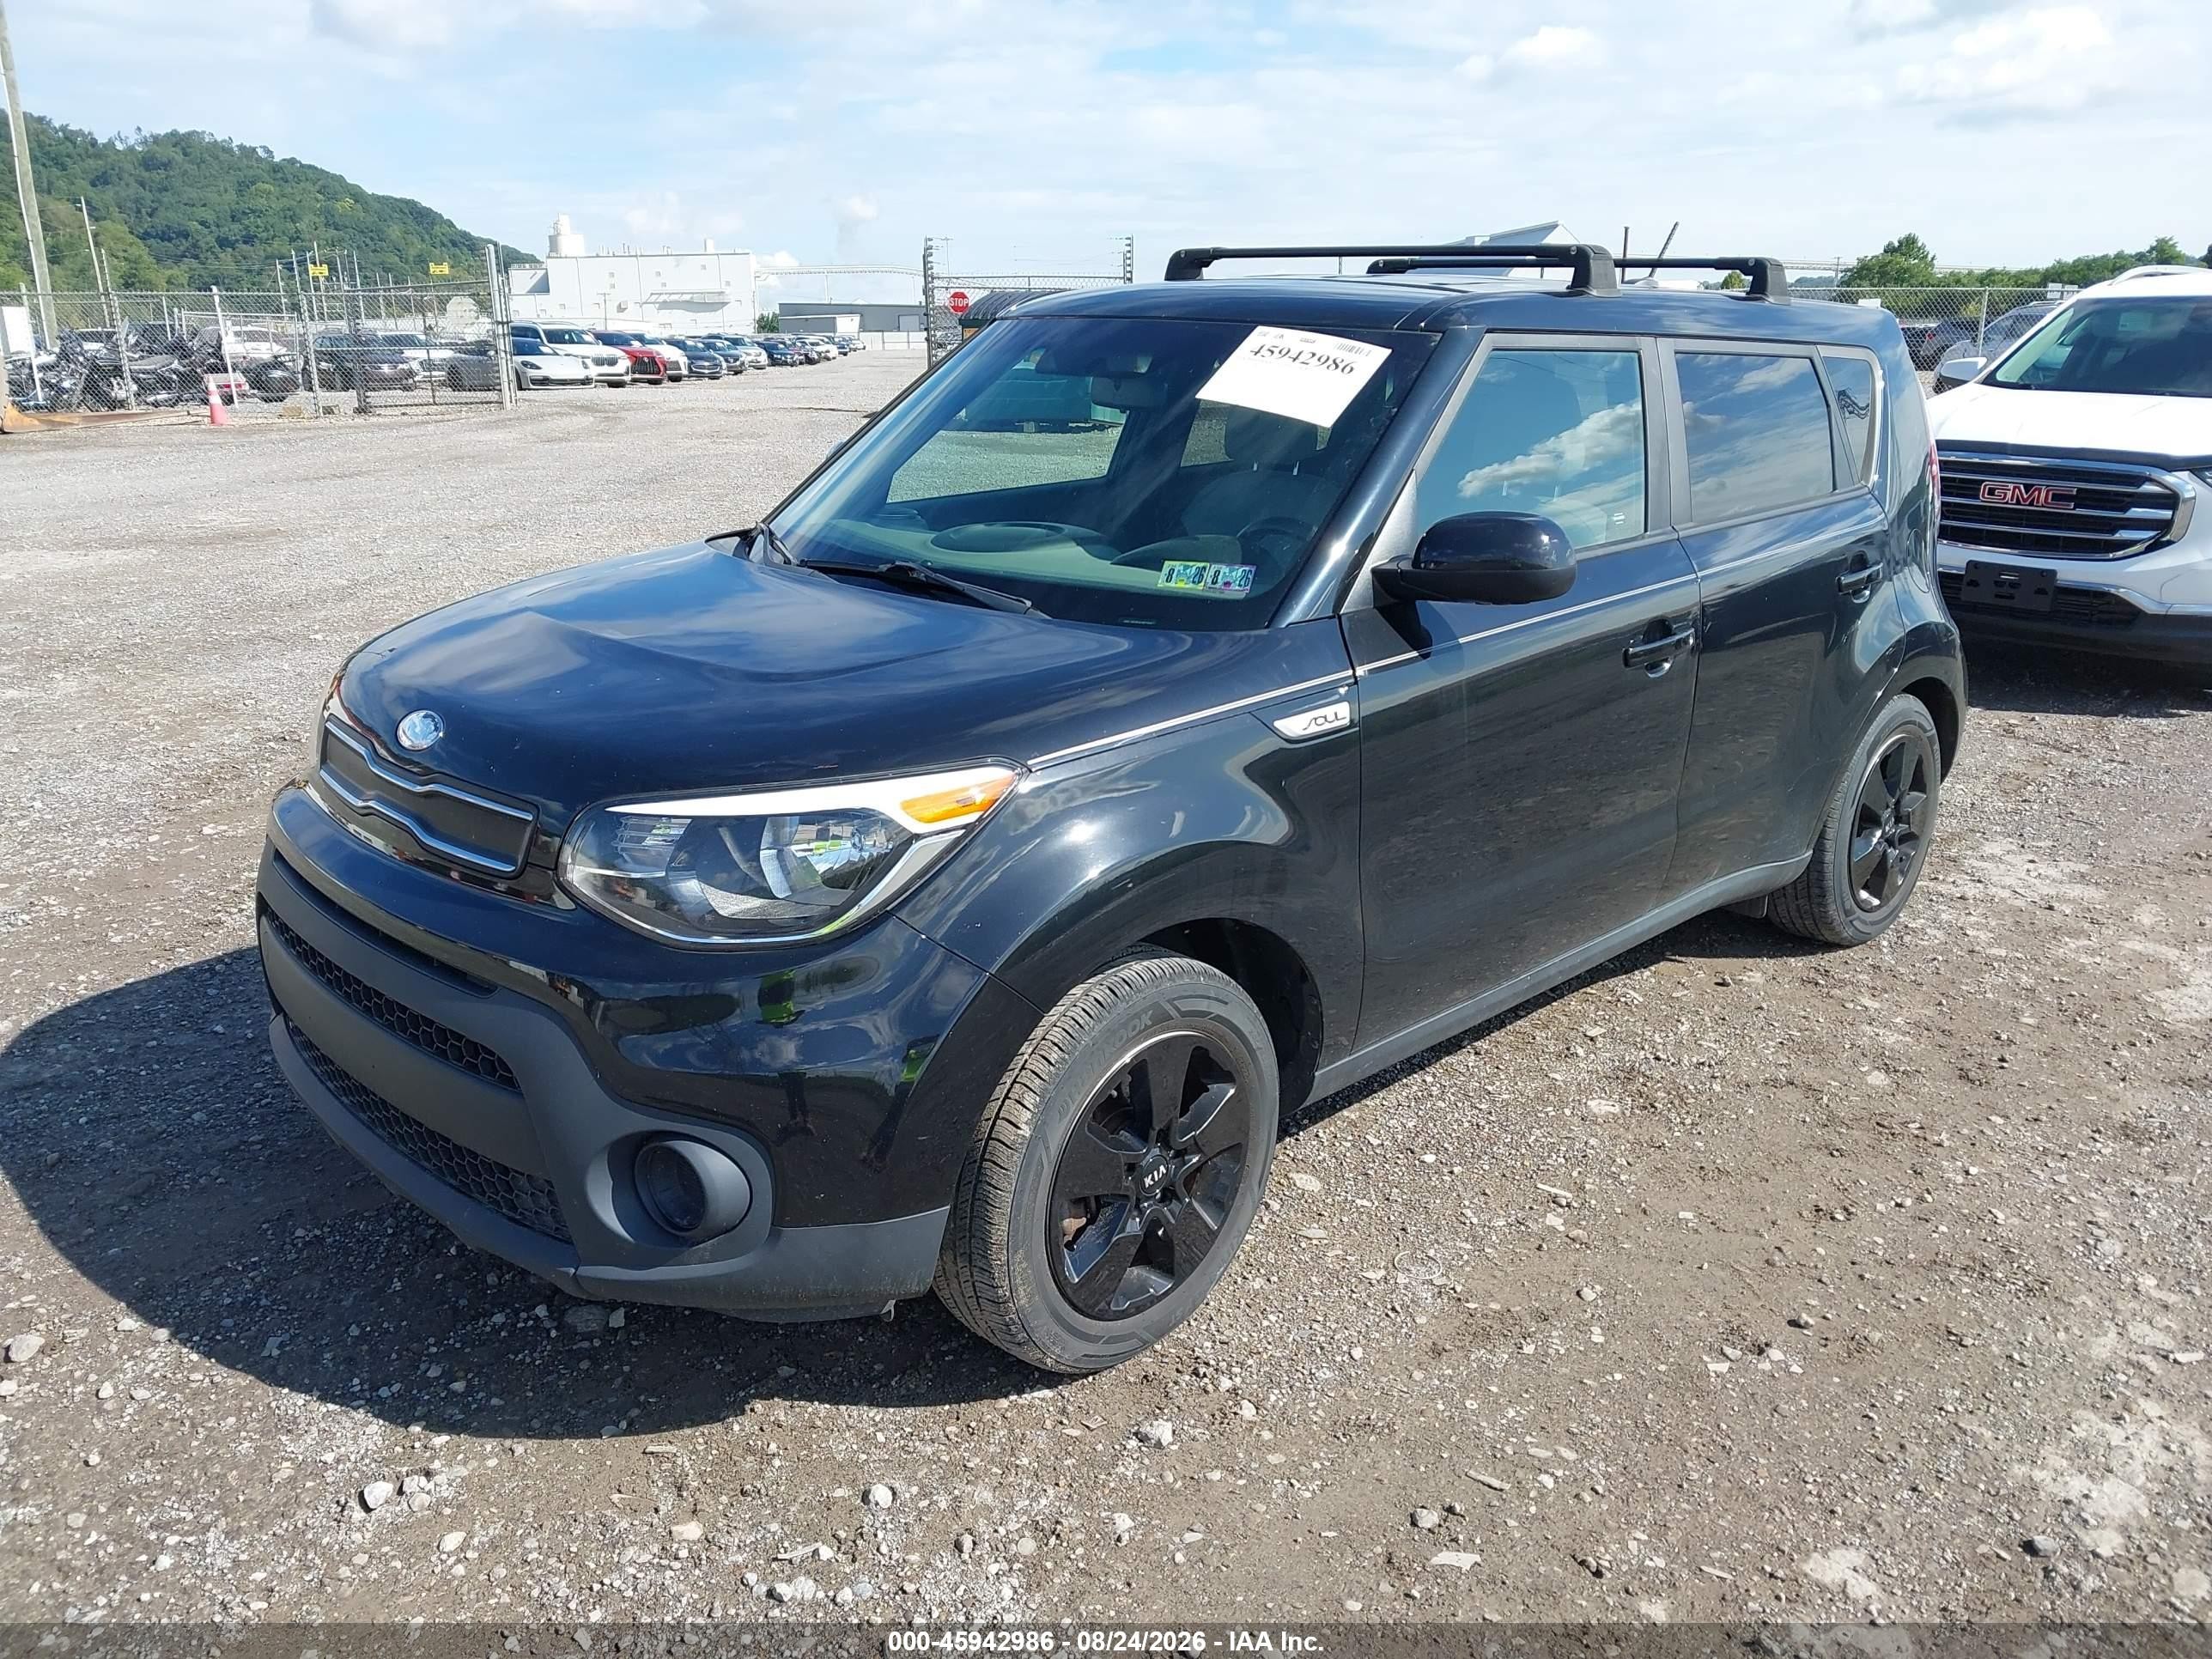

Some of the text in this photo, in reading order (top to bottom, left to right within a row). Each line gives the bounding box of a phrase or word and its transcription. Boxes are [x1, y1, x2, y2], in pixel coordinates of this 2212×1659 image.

[950, 297, 969, 307] STOP
[1249, 343, 1358, 375] 45942986
[1979, 481, 2078, 509] GMC
[1165, 566, 1206, 585] 8 26
[1211, 568, 1253, 587] 8 26
[1302, 711, 1347, 732] SOUL
[1143, 1164, 1167, 1188] KIA
